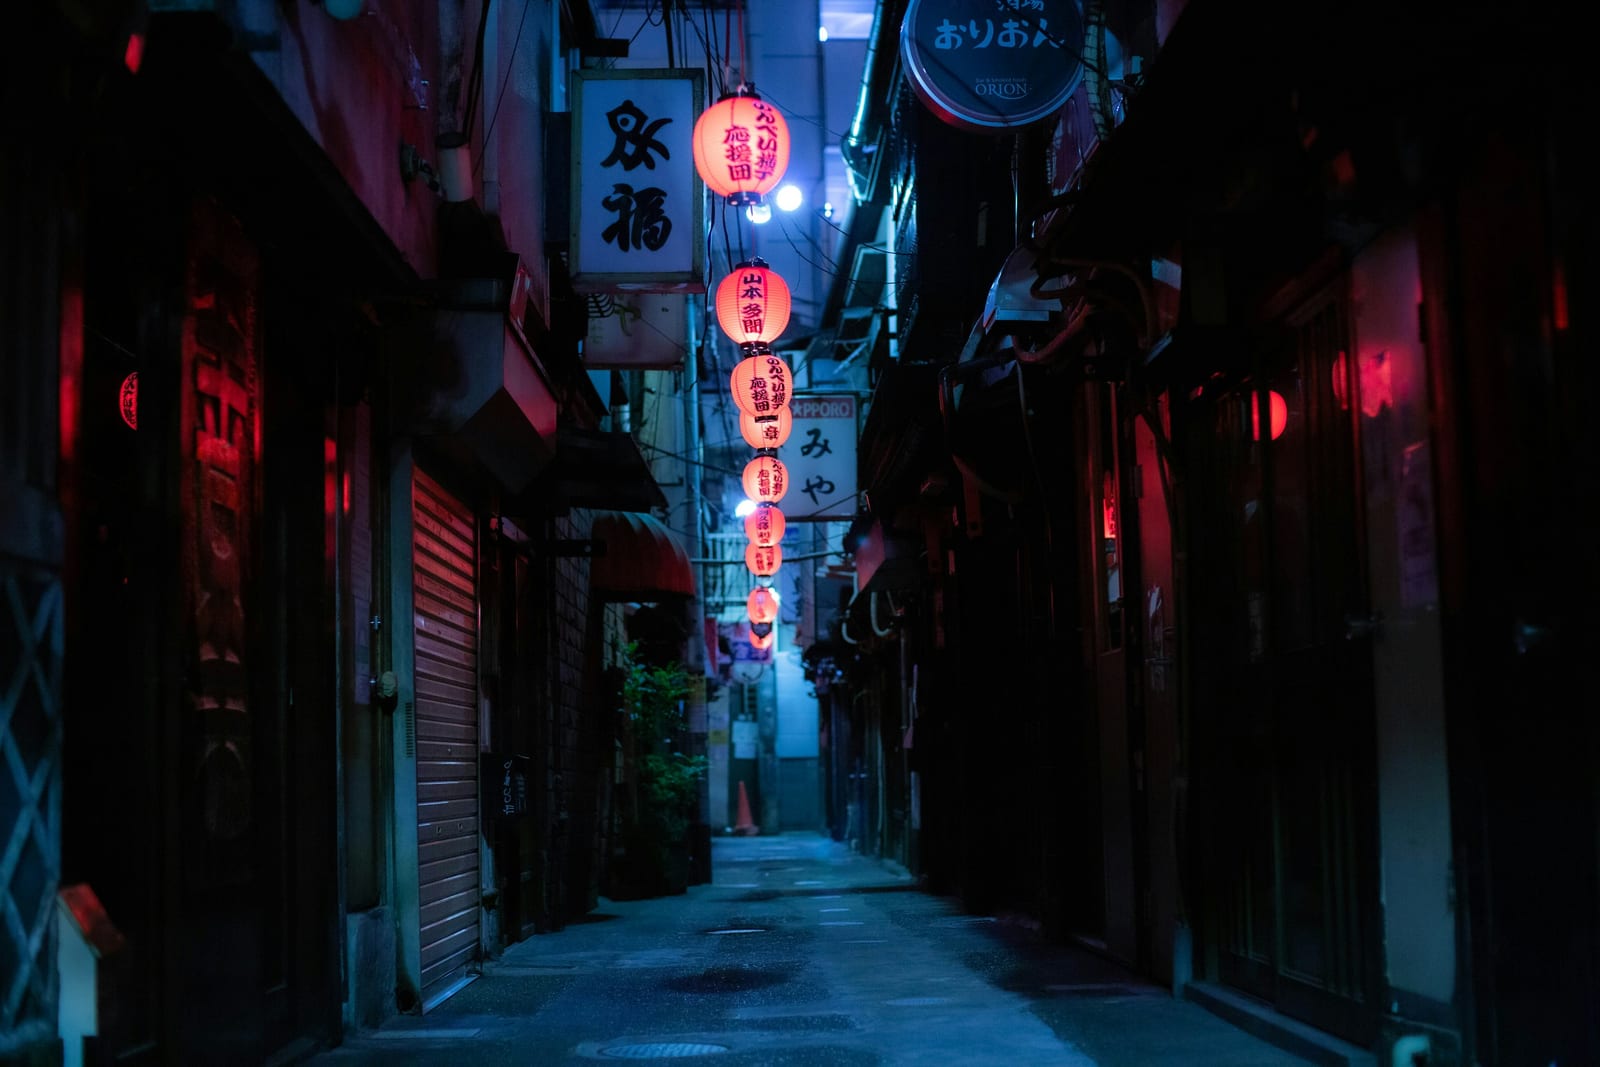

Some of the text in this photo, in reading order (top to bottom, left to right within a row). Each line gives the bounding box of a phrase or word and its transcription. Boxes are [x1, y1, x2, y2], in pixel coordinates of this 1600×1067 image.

[934, 17, 1065, 50] おりおん
[975, 83, 1027, 97] ORION
[793, 402, 850, 418] PPORO
[800, 428, 835, 505] みや
